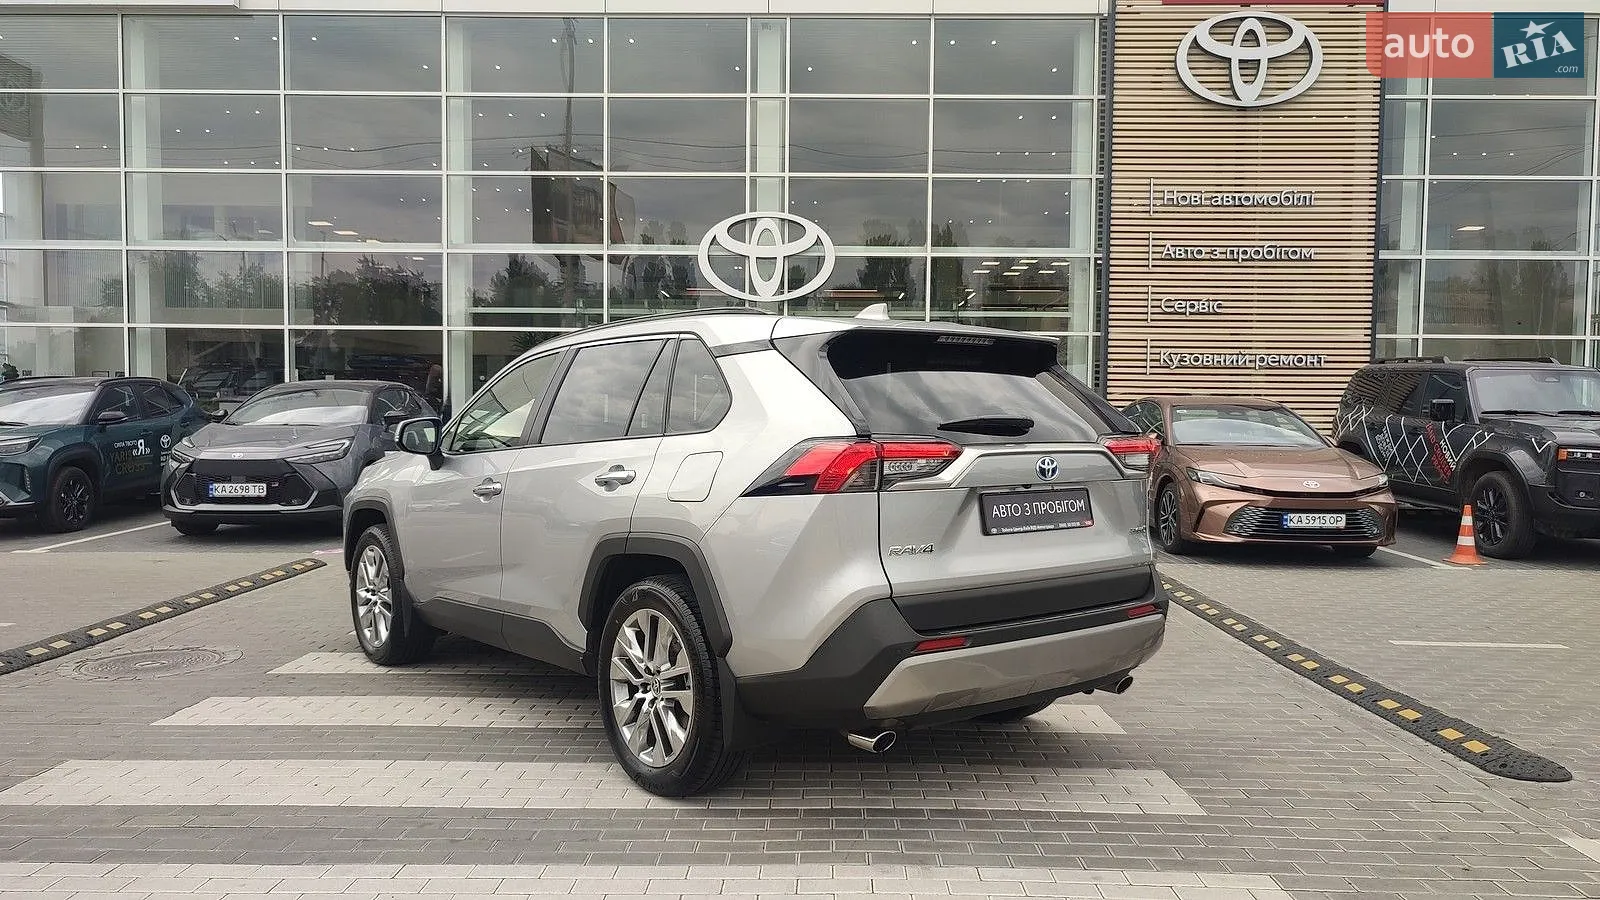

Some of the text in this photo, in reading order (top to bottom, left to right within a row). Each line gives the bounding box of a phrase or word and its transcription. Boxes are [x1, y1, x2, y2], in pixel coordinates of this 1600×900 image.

[1164, 190, 1316, 206] Нові автомобілі
[1161, 243, 1315, 263] Авто з пробігом
[1160, 297, 1224, 316] Сервіс
[1160, 350, 1327, 370] Кузовний ремонт
[228, 485, 250, 494] 2698
[992, 499, 1086, 519] АВТО З ПРОБІГОМ
[1305, 515, 1327, 525] 5915
[888, 542, 936, 557] RAV4
